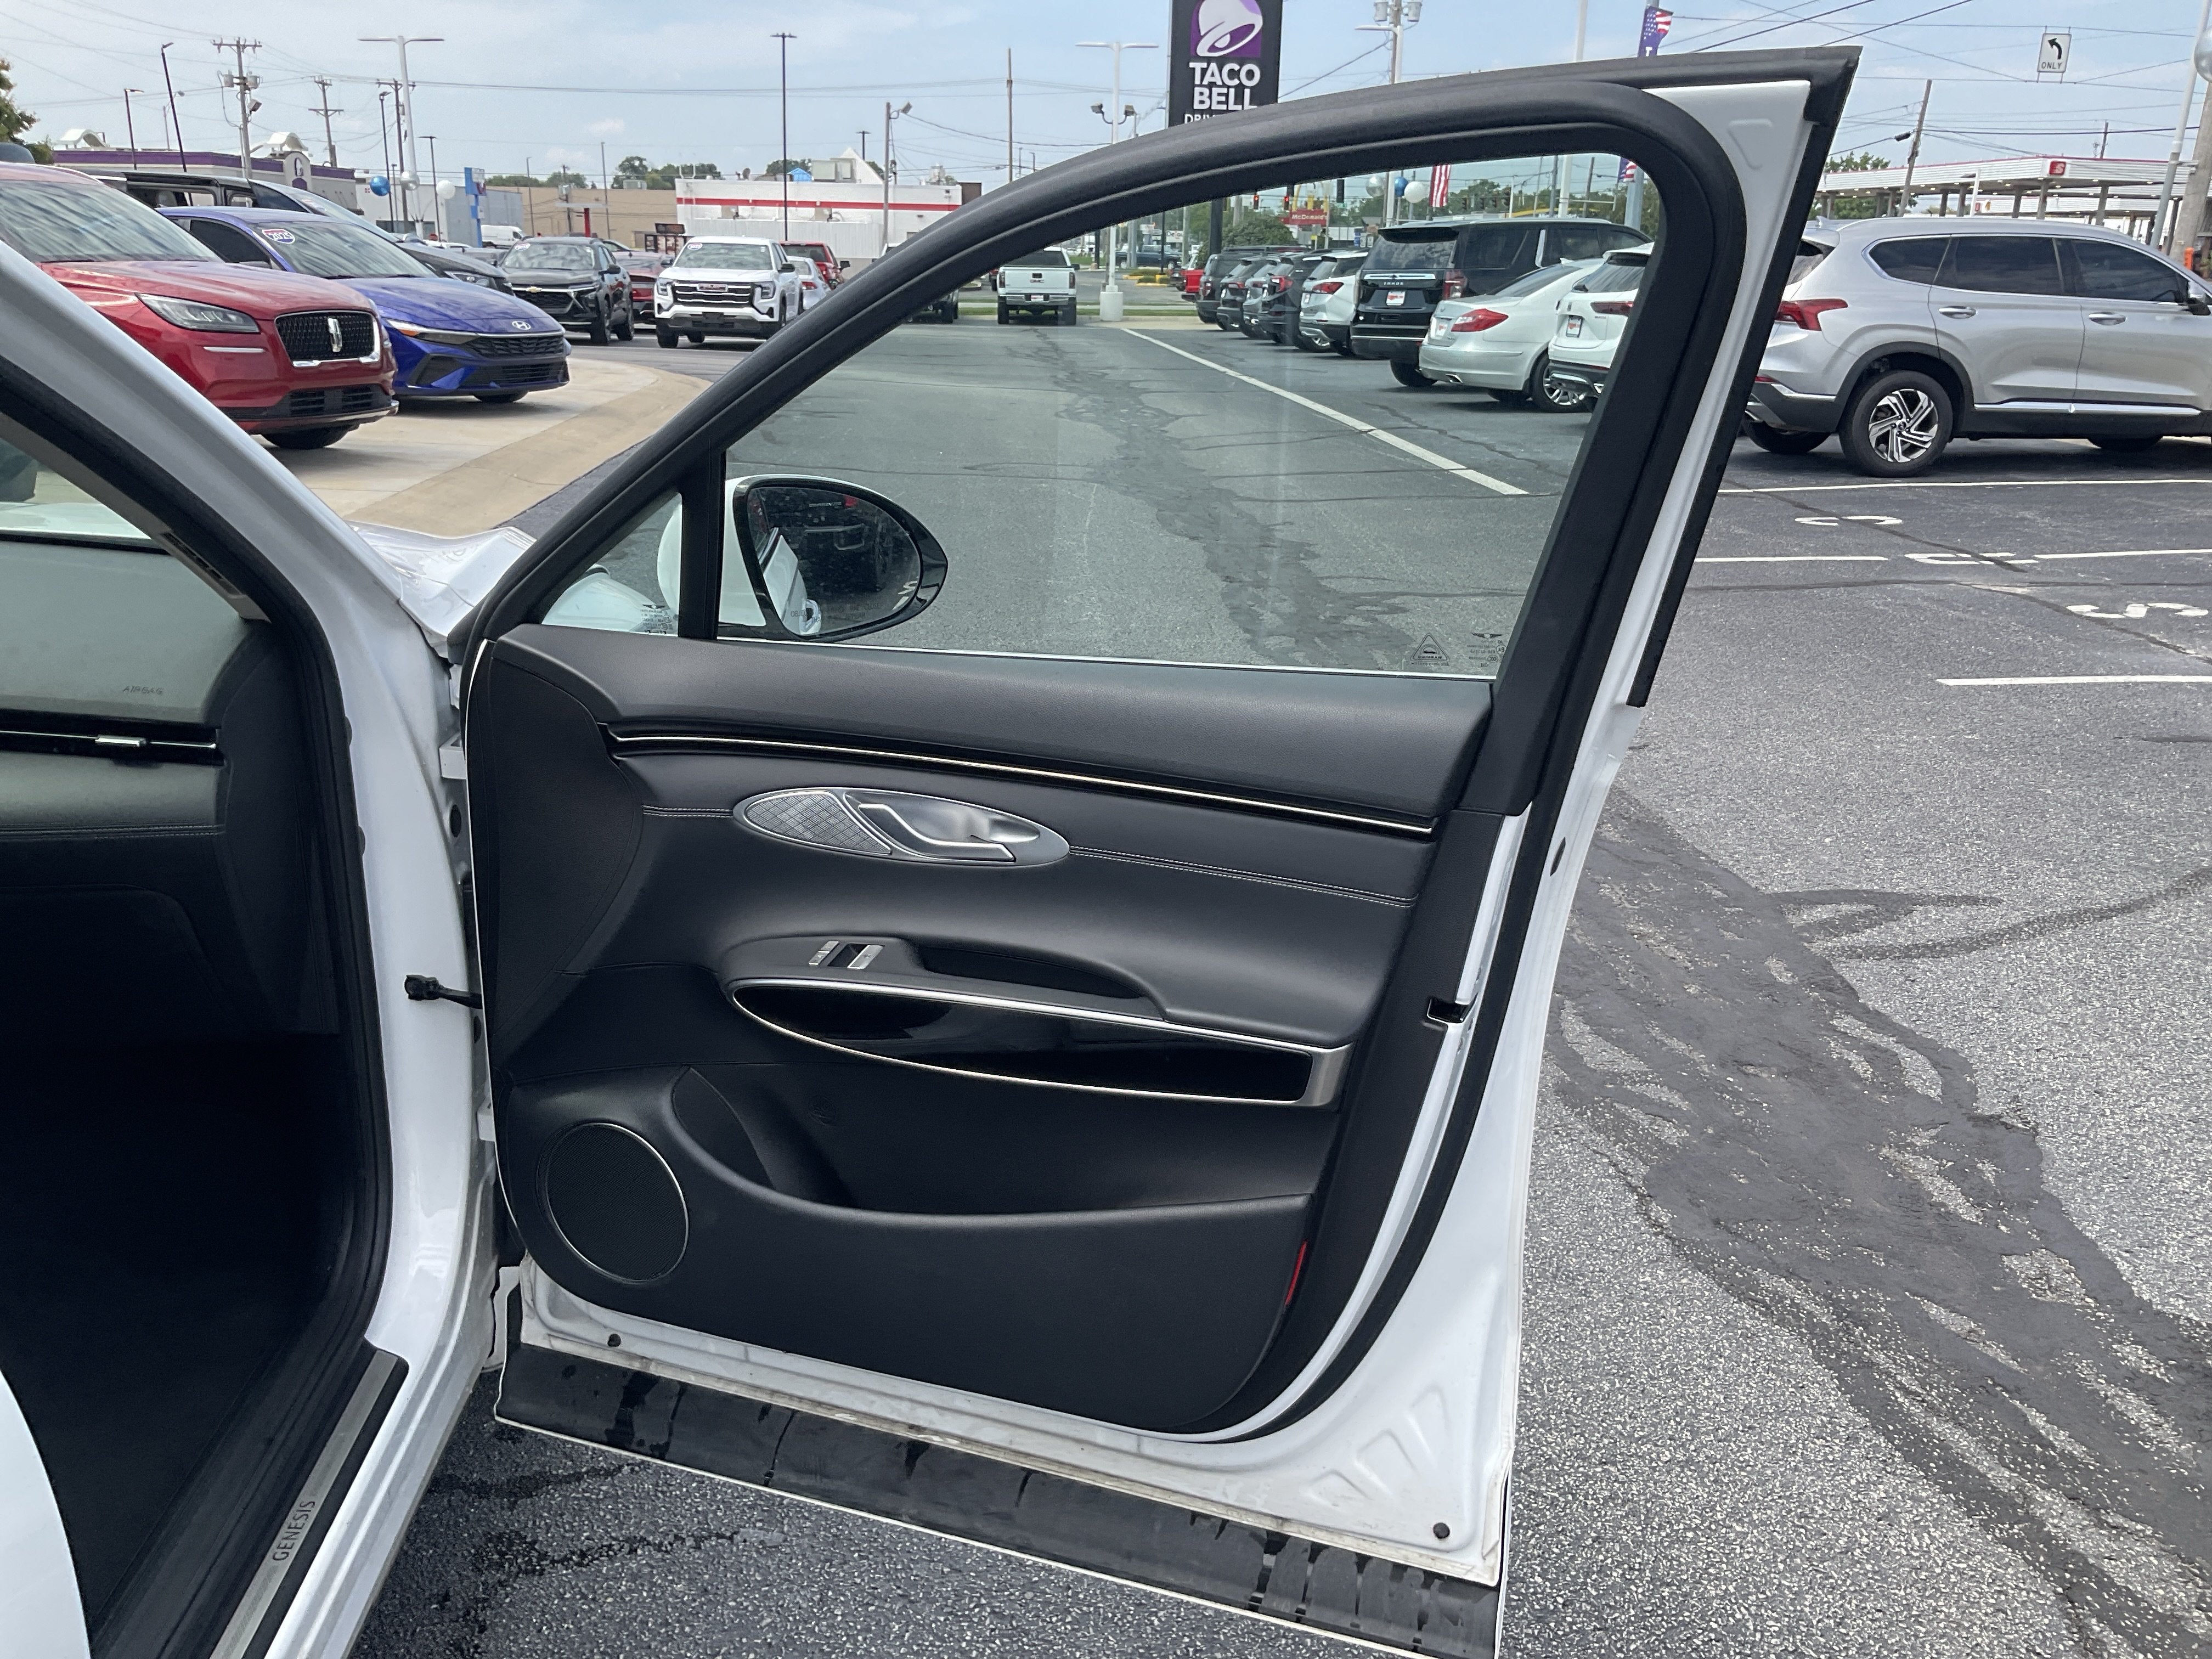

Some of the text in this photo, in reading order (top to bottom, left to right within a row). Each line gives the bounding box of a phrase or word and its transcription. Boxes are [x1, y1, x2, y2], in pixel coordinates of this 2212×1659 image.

[1189, 62, 1261, 87] TACO
[1193, 87, 1257, 110] BELL
[122, 685, 164, 696] AIRBAG
[273, 1500, 315, 1561] GENESIS
